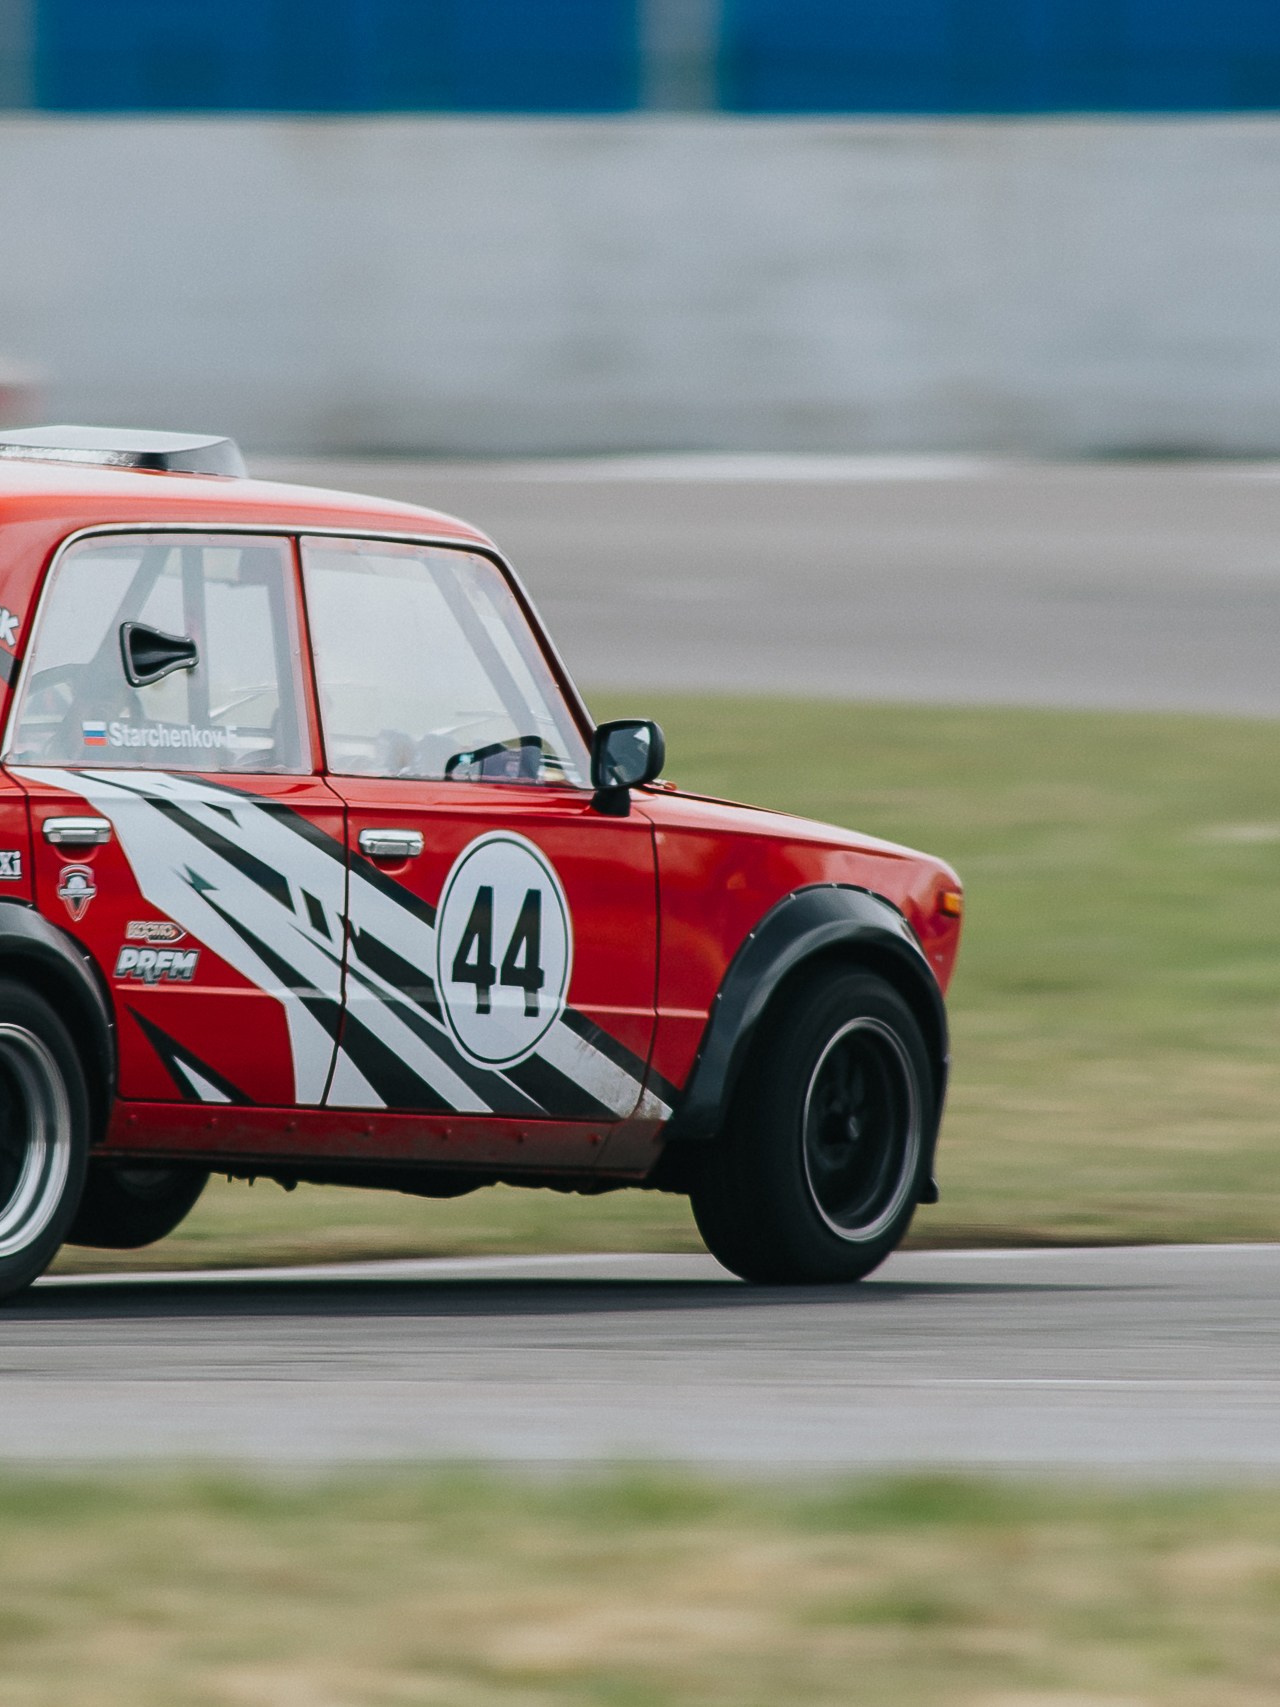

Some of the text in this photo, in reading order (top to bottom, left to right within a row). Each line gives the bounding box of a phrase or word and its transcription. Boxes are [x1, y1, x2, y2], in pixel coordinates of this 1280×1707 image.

[109, 722, 222, 748] Starchenkov
[116, 947, 199, 982] PRFM
[452, 885, 544, 1017] 44
